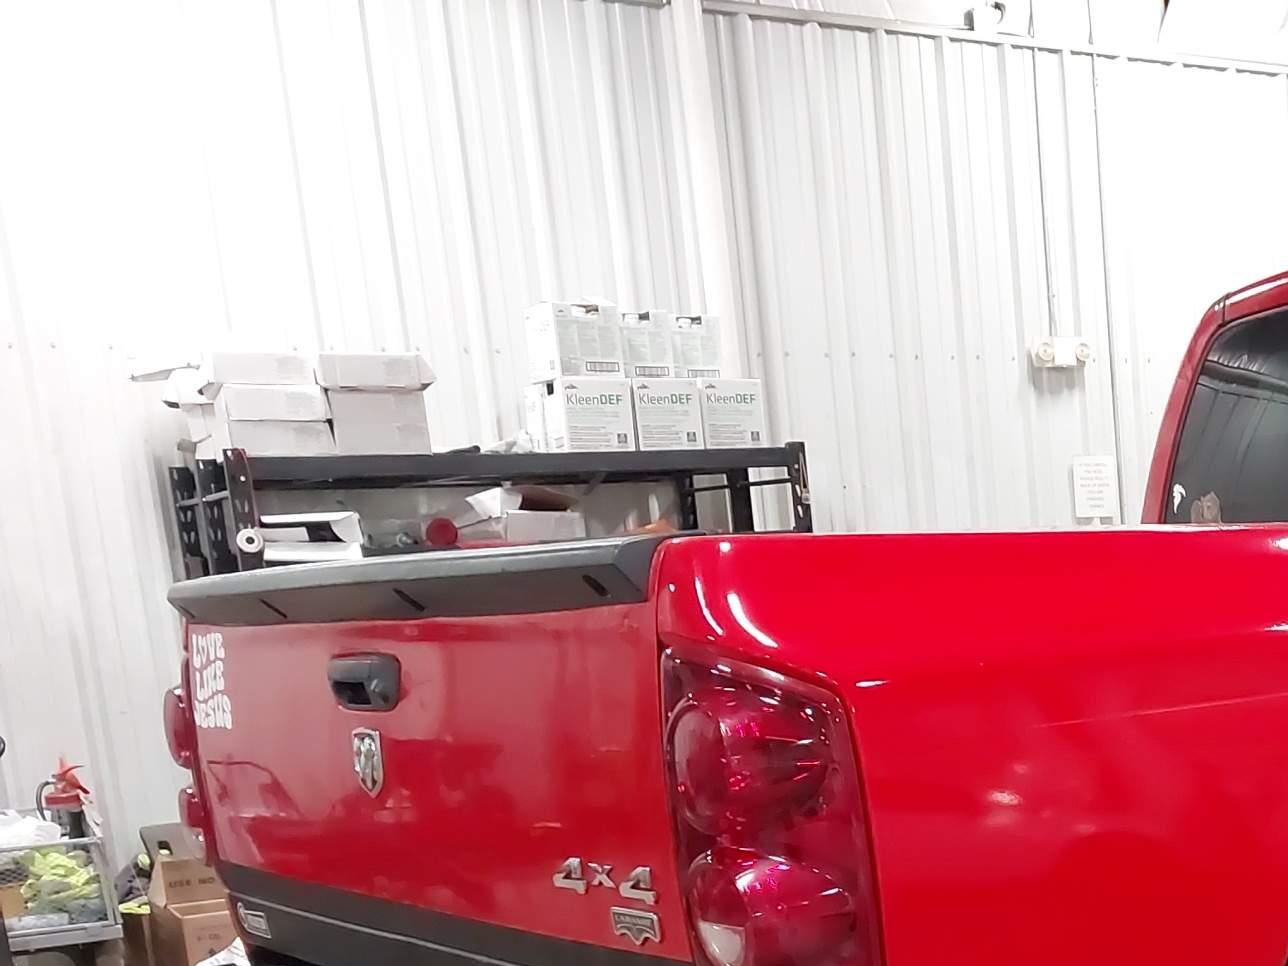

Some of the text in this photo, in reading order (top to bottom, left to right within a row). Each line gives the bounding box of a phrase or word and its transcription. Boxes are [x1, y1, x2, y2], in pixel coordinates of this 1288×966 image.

[566, 393, 623, 405] KleenDEF
[639, 393, 692, 405] KleenDEF
[706, 393, 756, 405] KleenDEF
